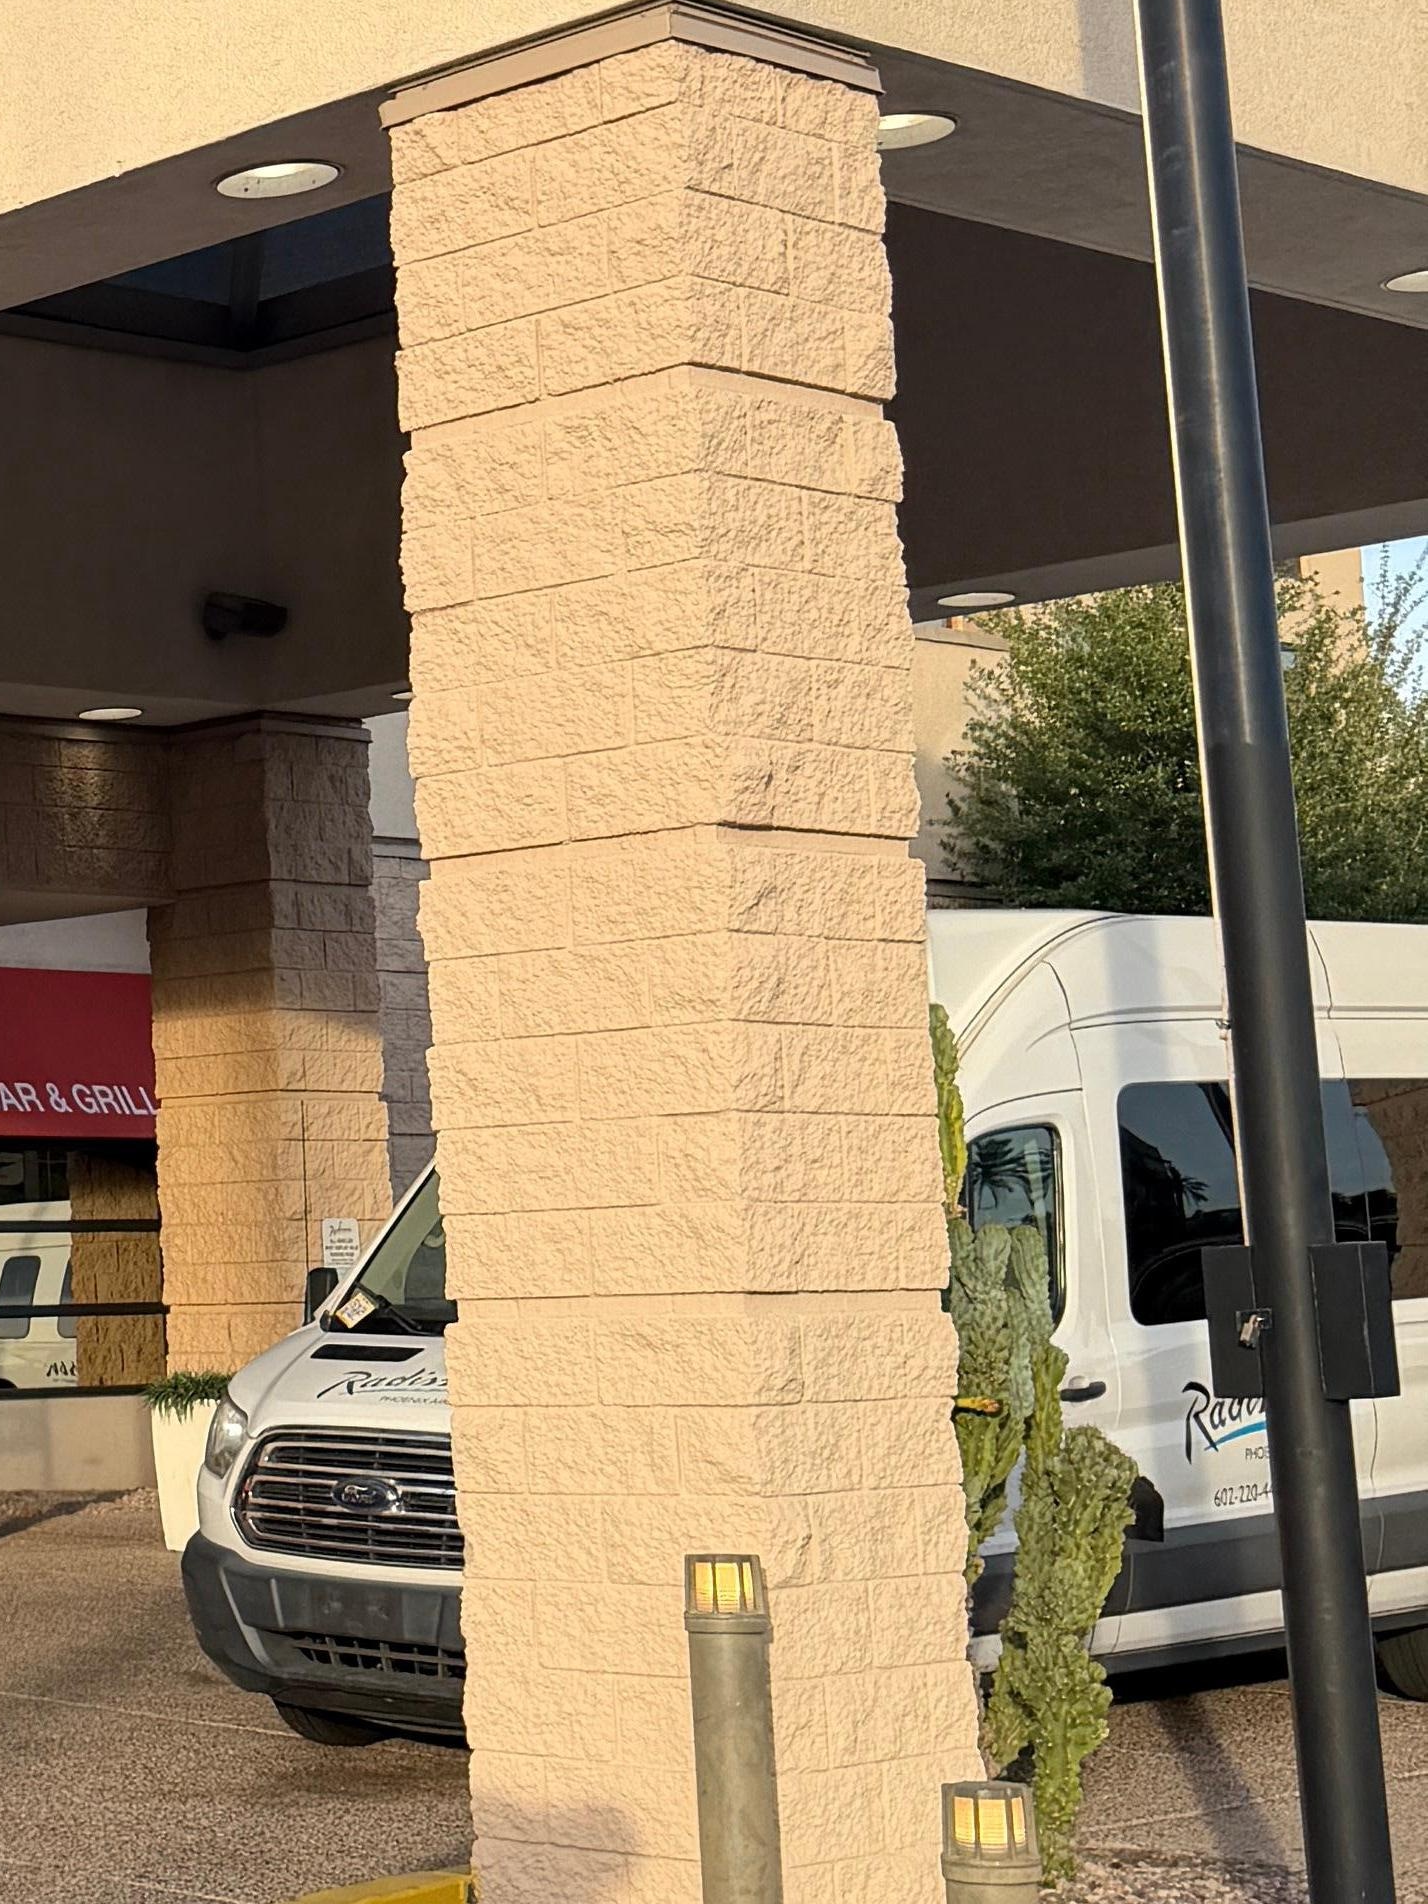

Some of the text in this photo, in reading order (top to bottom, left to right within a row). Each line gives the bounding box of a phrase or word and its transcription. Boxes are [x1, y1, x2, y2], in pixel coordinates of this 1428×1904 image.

[46, 1081, 73, 1114] &
[71, 1083, 158, 1116] GRILL
[1214, 1482, 1273, 1508] 602-220-4
